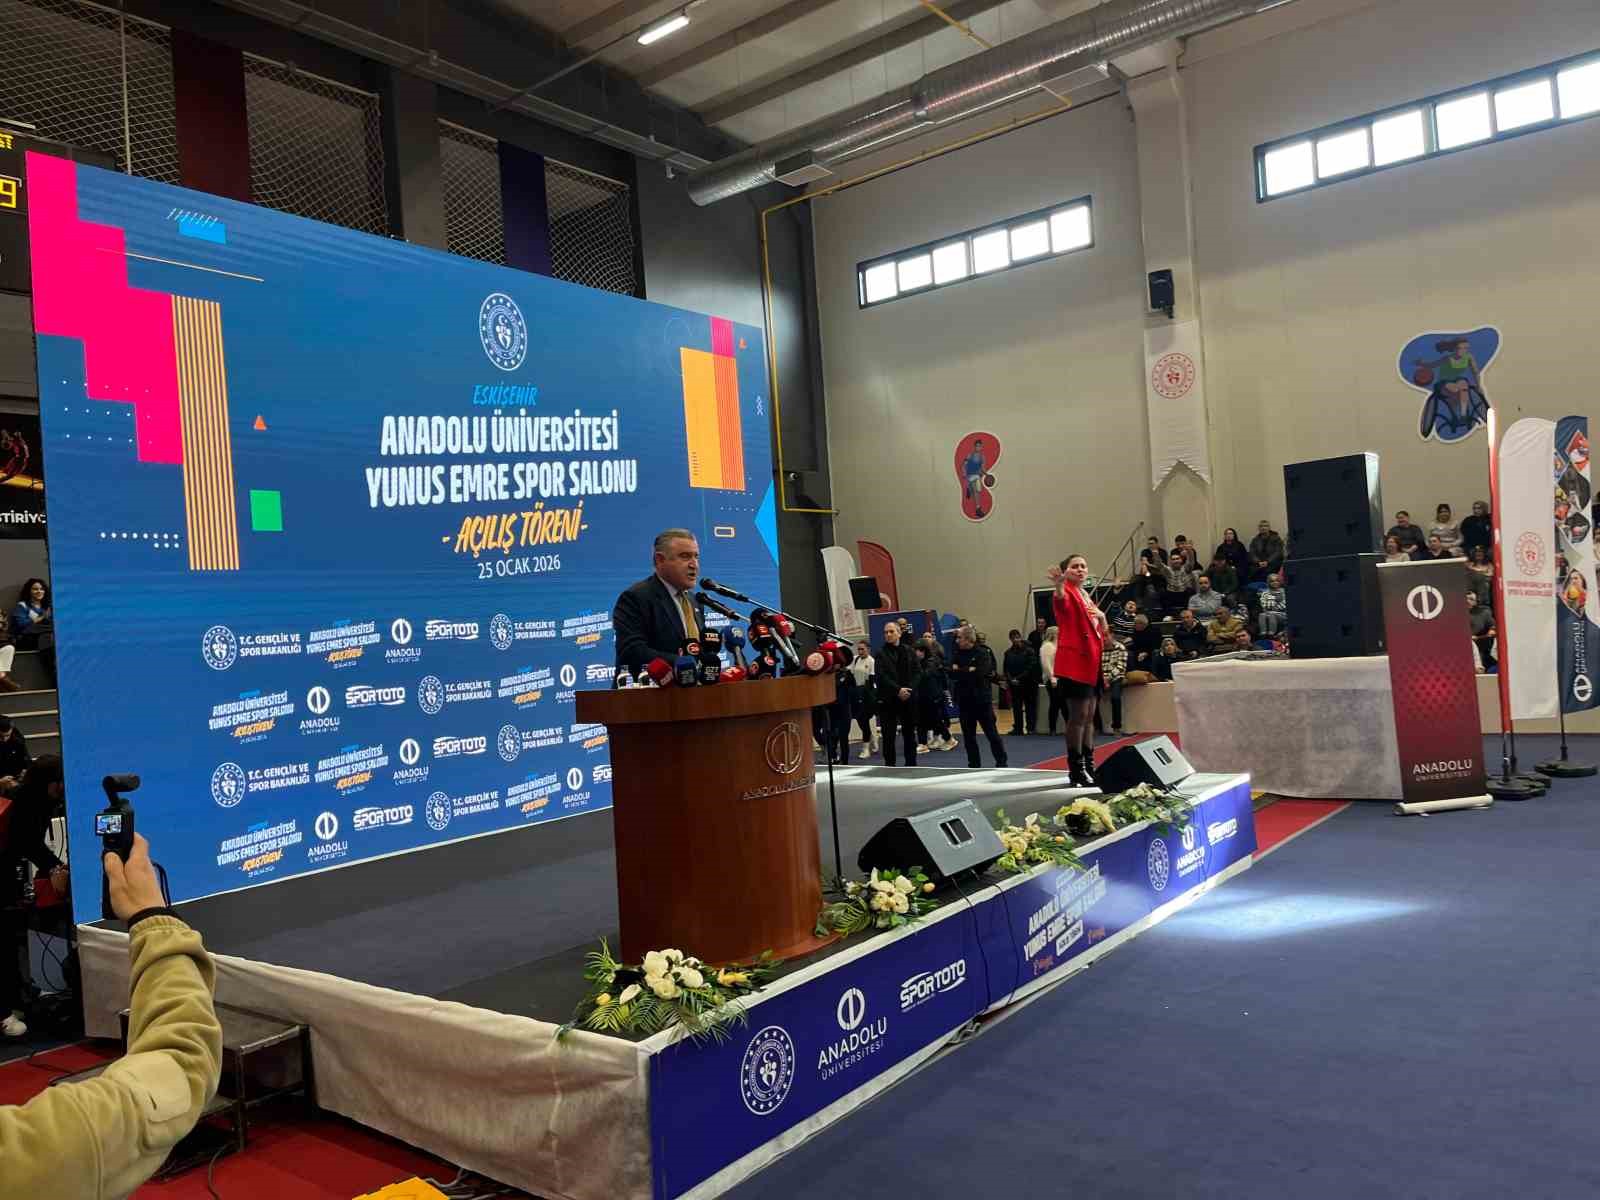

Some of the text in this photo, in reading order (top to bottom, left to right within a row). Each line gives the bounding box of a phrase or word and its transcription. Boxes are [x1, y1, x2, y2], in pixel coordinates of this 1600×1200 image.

[473, 381, 538, 407] ESKİŞEHİR
[380, 408, 619, 456] ANADOLU ÜNİVERSİTESİ
[366, 459, 637, 508] YUNUS EMRE SPOR SALONU
[454, 513, 517, 558] AÇILIŞ
[477, 554, 561, 579] 25 OCAK 2026
[425, 621, 478, 638] SPORTOTO
[385, 647, 421, 658] ANADOLU
[345, 686, 405, 705] SPORTOTO
[300, 717, 340, 730] ANADOLU
[433, 736, 487, 756] SPORTOTO
[393, 766, 429, 780] ANADOLU
[1412, 759, 1473, 775] ANADOLU
[353, 804, 414, 829] SPORTOTO
[307, 840, 348, 857] ANADOLU
[900, 958, 967, 1010] SPORTOTO
[817, 1016, 888, 1070] ANADOLU
